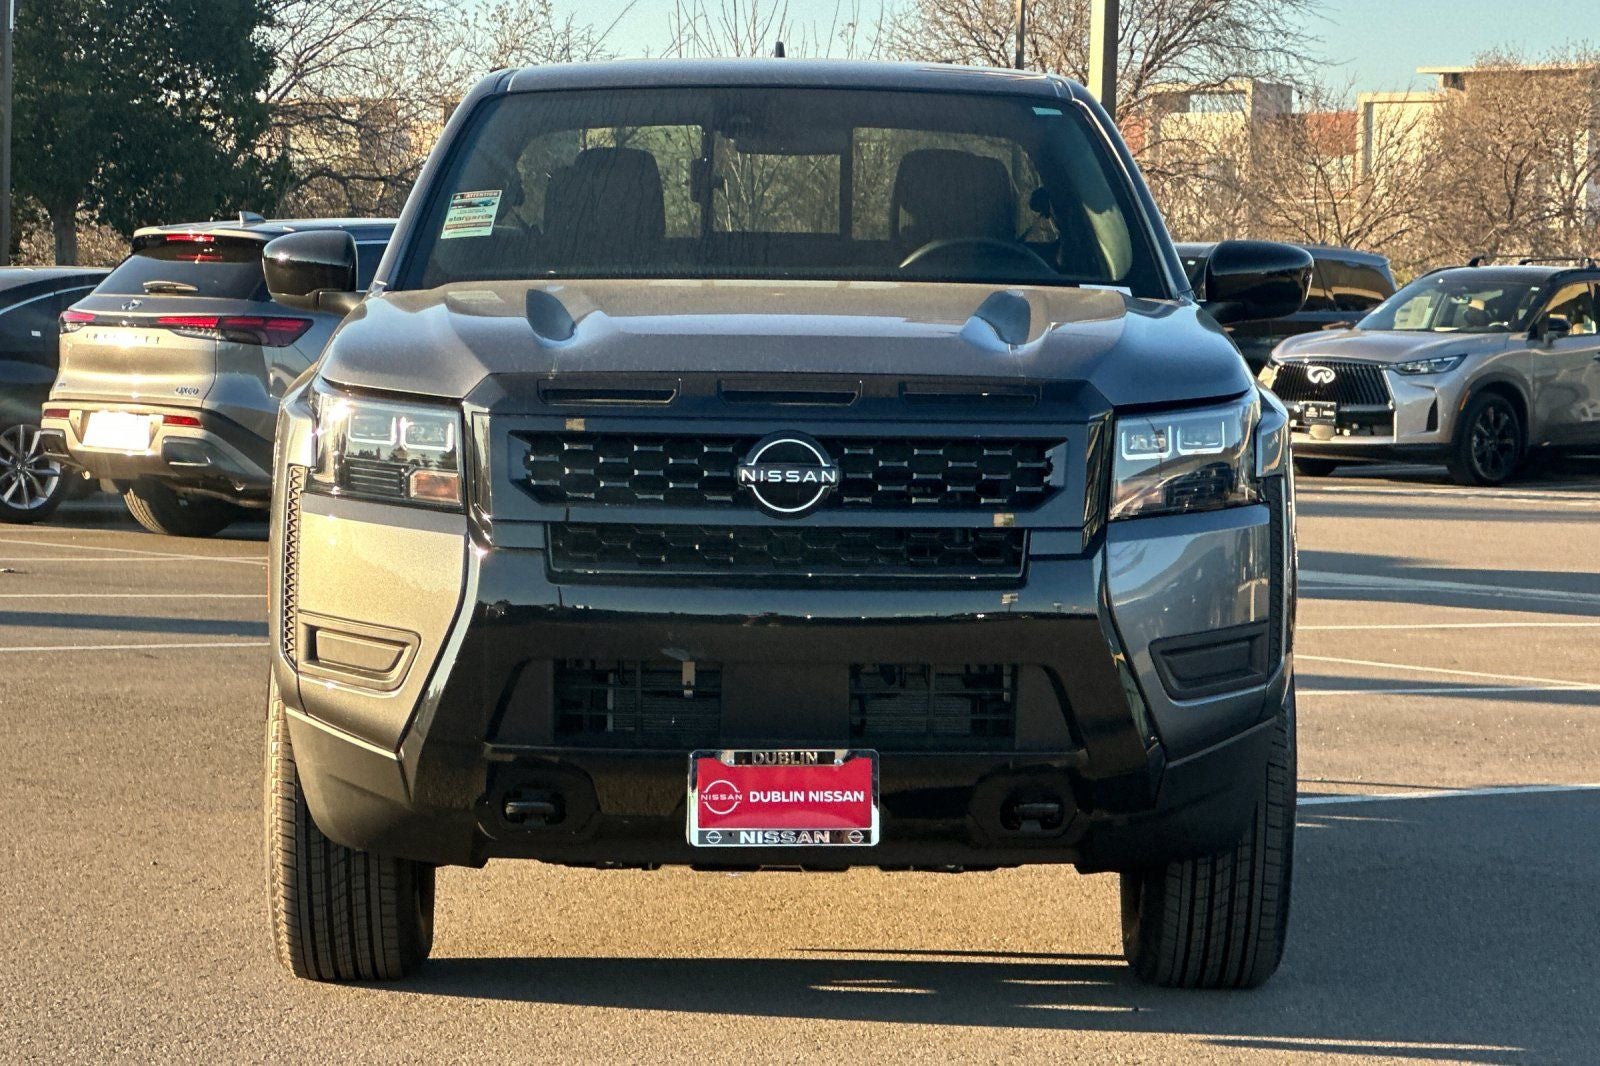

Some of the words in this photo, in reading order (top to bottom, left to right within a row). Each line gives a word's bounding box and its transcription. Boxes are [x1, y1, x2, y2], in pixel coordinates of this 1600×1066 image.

[741, 469, 836, 483] NISSAN
[752, 752, 818, 765] DUBLIN
[750, 791, 805, 803] DUBLIN
[808, 791, 864, 803] NISSAN
[739, 831, 831, 844] NISSAN
